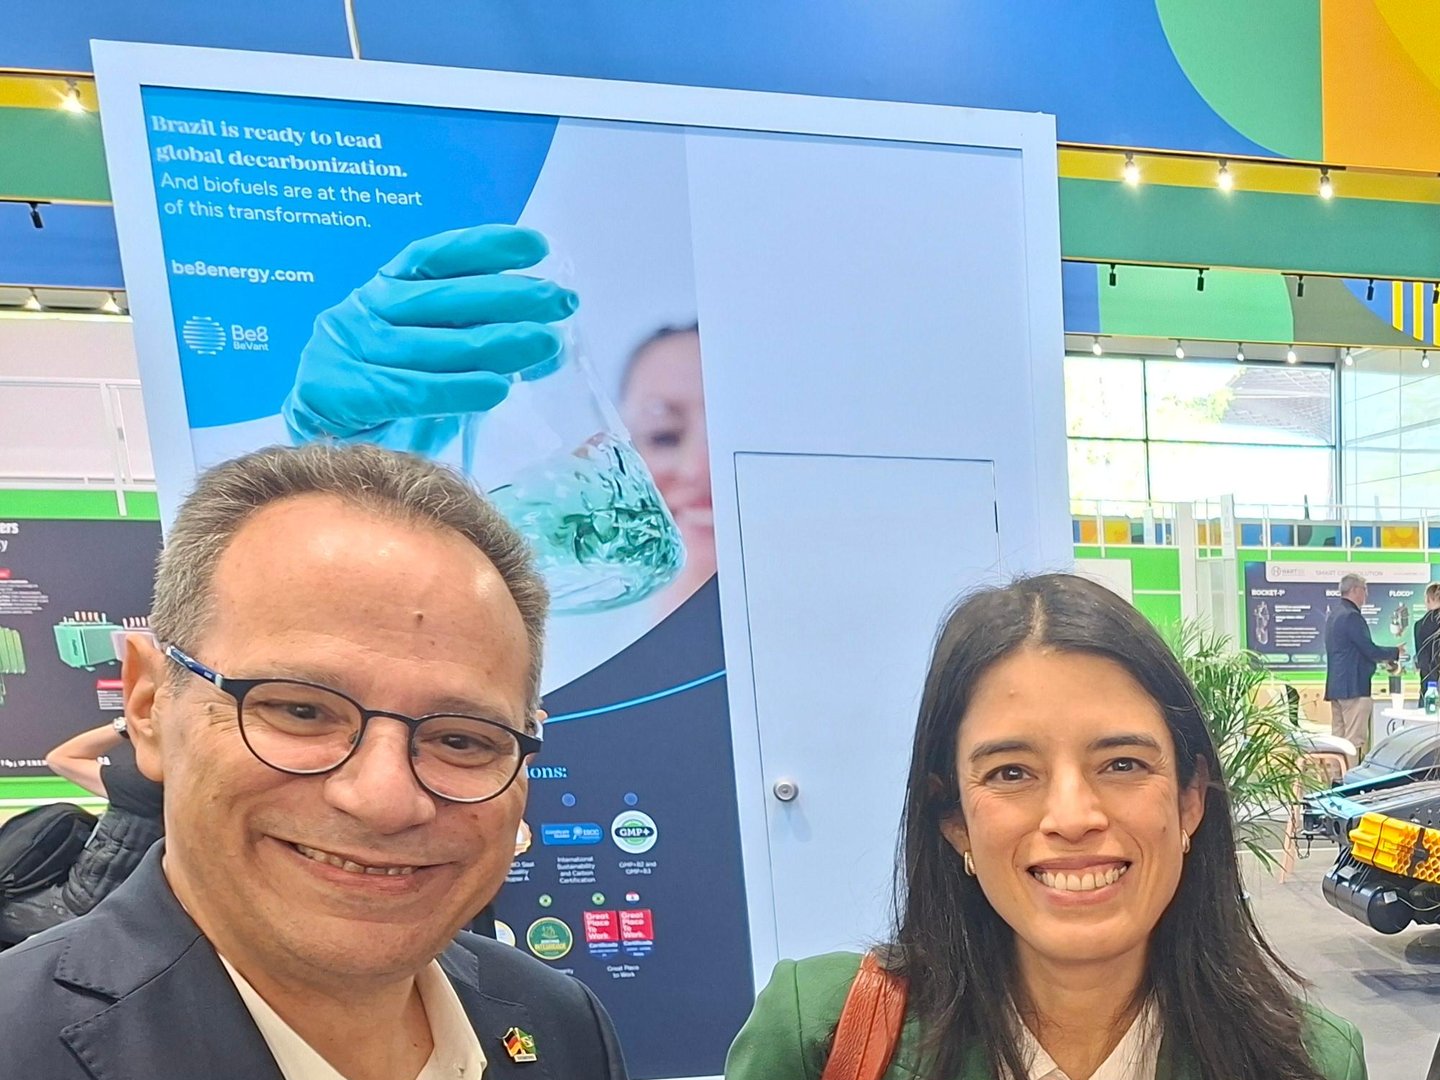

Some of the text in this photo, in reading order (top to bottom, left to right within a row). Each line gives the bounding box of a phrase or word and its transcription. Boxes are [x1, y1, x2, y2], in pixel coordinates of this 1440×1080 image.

[151, 115, 383, 149] Brazil is ready to lead
[156, 144, 408, 177] global decarbonization.
[160, 172, 423, 206] And biofuels are at the heart
[164, 199, 371, 228] of this transformation.
[171, 259, 315, 283] be8energy.com
[231, 324, 269, 342] Be8
[233, 342, 269, 351] BeVant
[619, 828, 650, 837] GMP+
